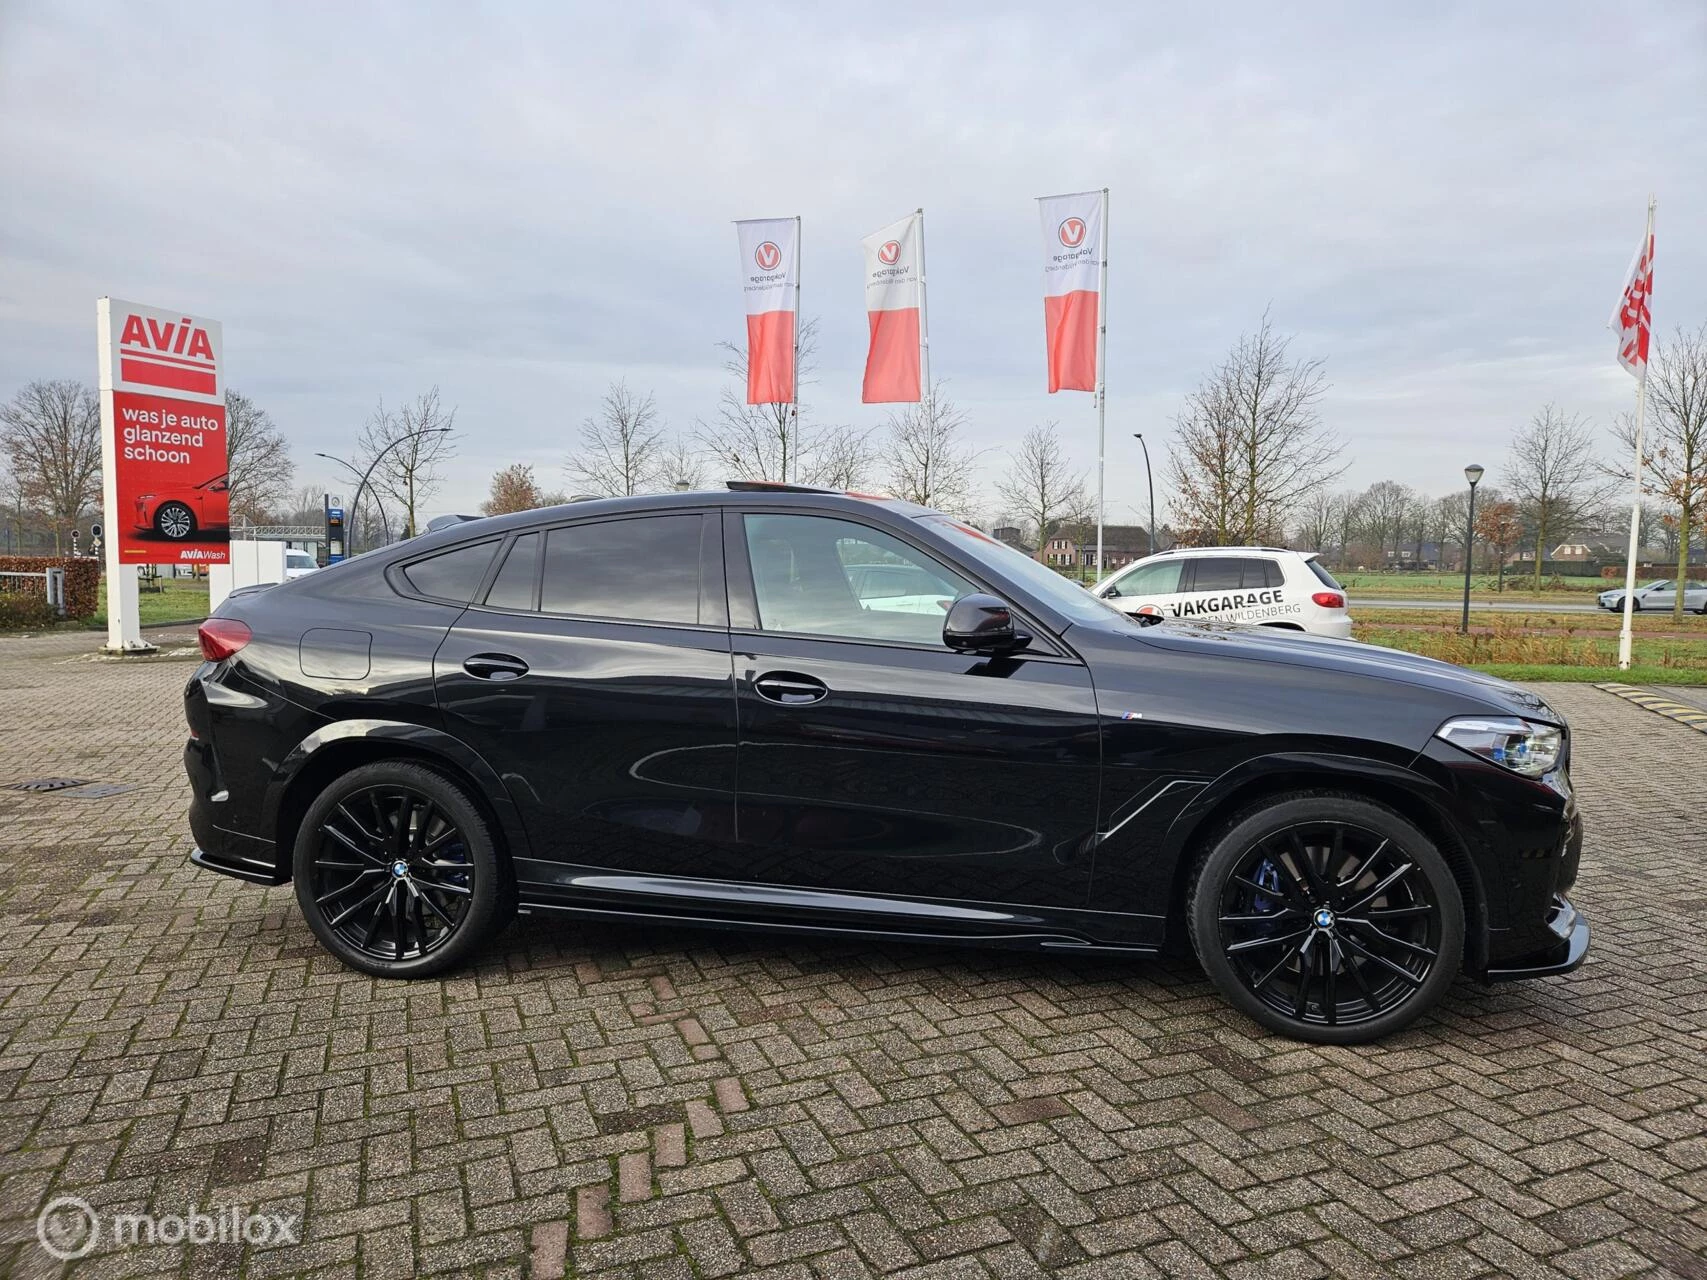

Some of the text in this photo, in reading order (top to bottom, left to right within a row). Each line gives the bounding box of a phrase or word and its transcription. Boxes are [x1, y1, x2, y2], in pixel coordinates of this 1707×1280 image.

[122, 407, 218, 431] was je auto
[123, 425, 203, 447] glanzend
[124, 445, 190, 464] schoon
[1172, 590, 1284, 617] VAKGARAGE
[1226, 603, 1301, 622] WILDENBERG
